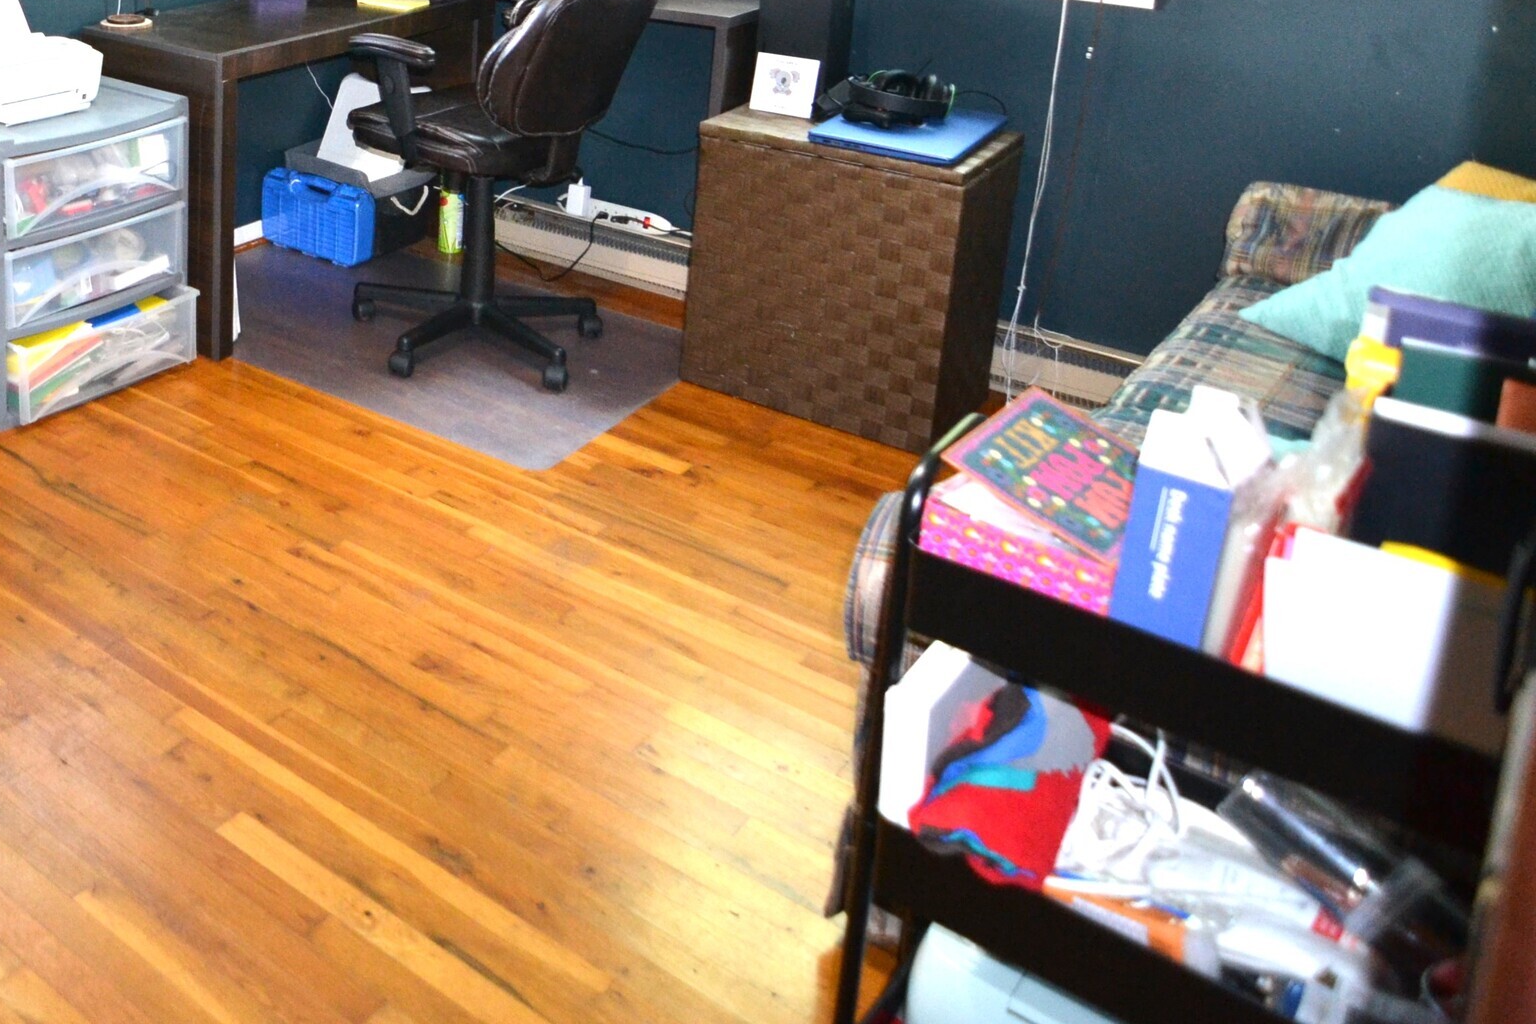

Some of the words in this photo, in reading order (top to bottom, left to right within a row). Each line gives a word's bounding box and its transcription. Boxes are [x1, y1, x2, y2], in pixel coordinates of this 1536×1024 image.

[993, 419, 1060, 469] KIT
[1029, 442, 1106, 500] POM
[1165, 488, 1189, 523] Desk
[1156, 523, 1178, 563] name
[1148, 560, 1170, 599] plate
